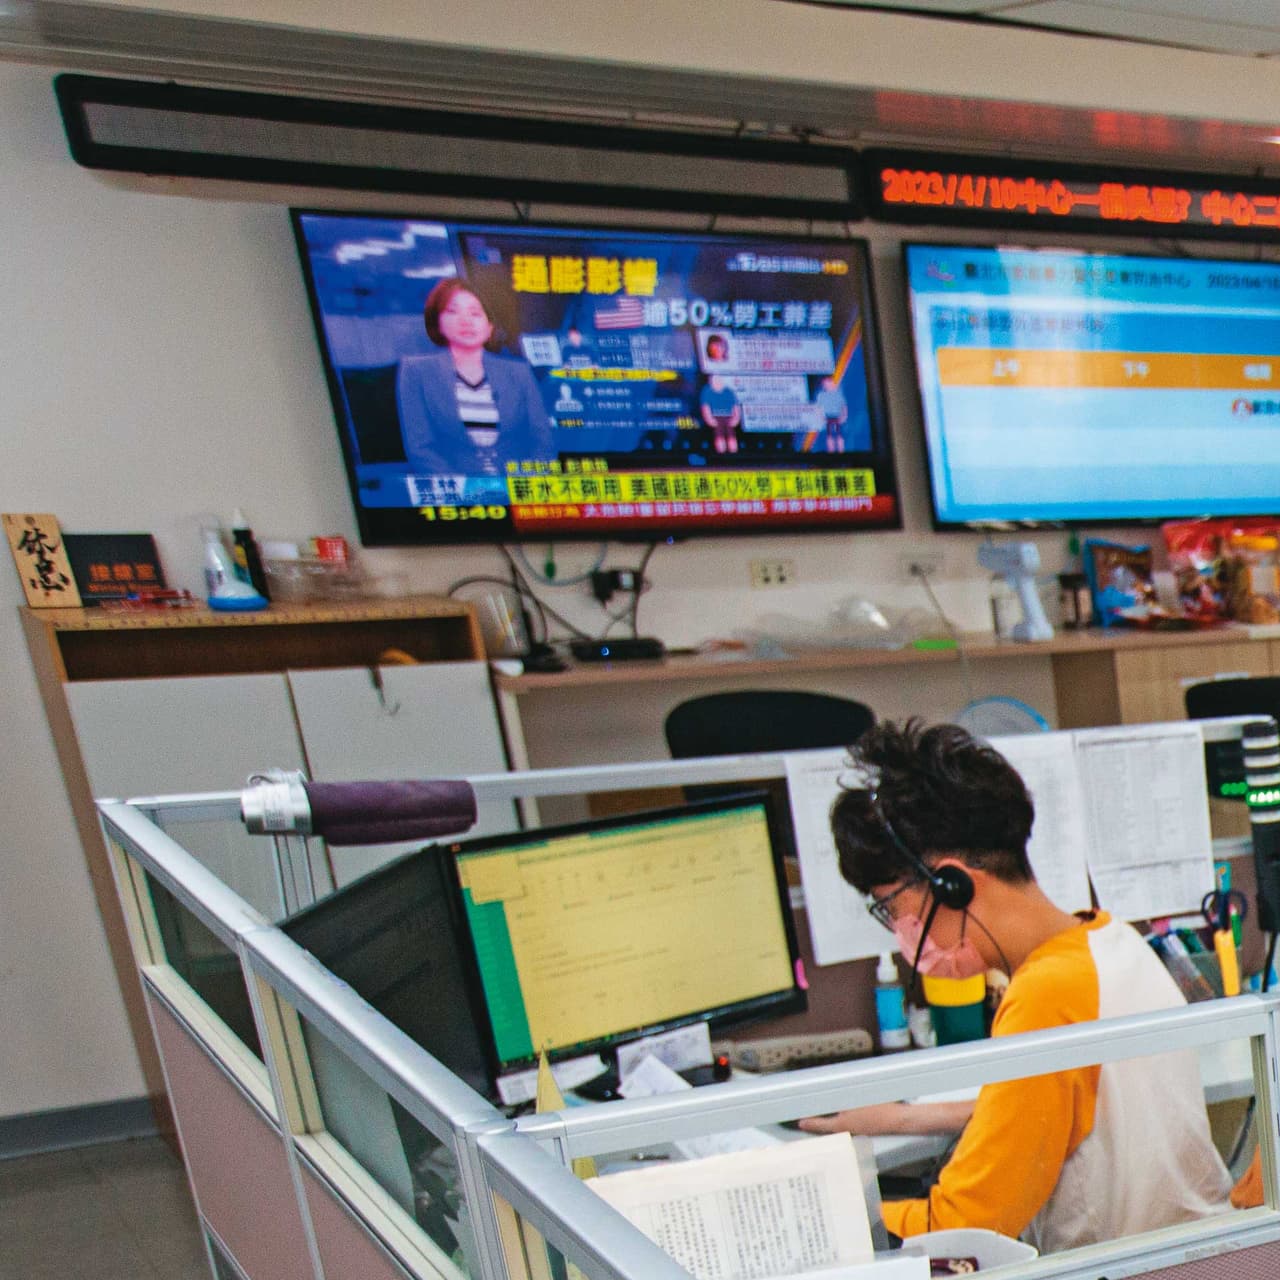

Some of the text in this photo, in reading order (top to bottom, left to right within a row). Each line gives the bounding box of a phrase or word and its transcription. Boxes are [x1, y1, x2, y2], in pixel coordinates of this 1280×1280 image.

[512, 254, 658, 296] 通膨影響
[643, 300, 833, 329] 逾50%勞工兼差
[419, 505, 507, 521] 15:40
